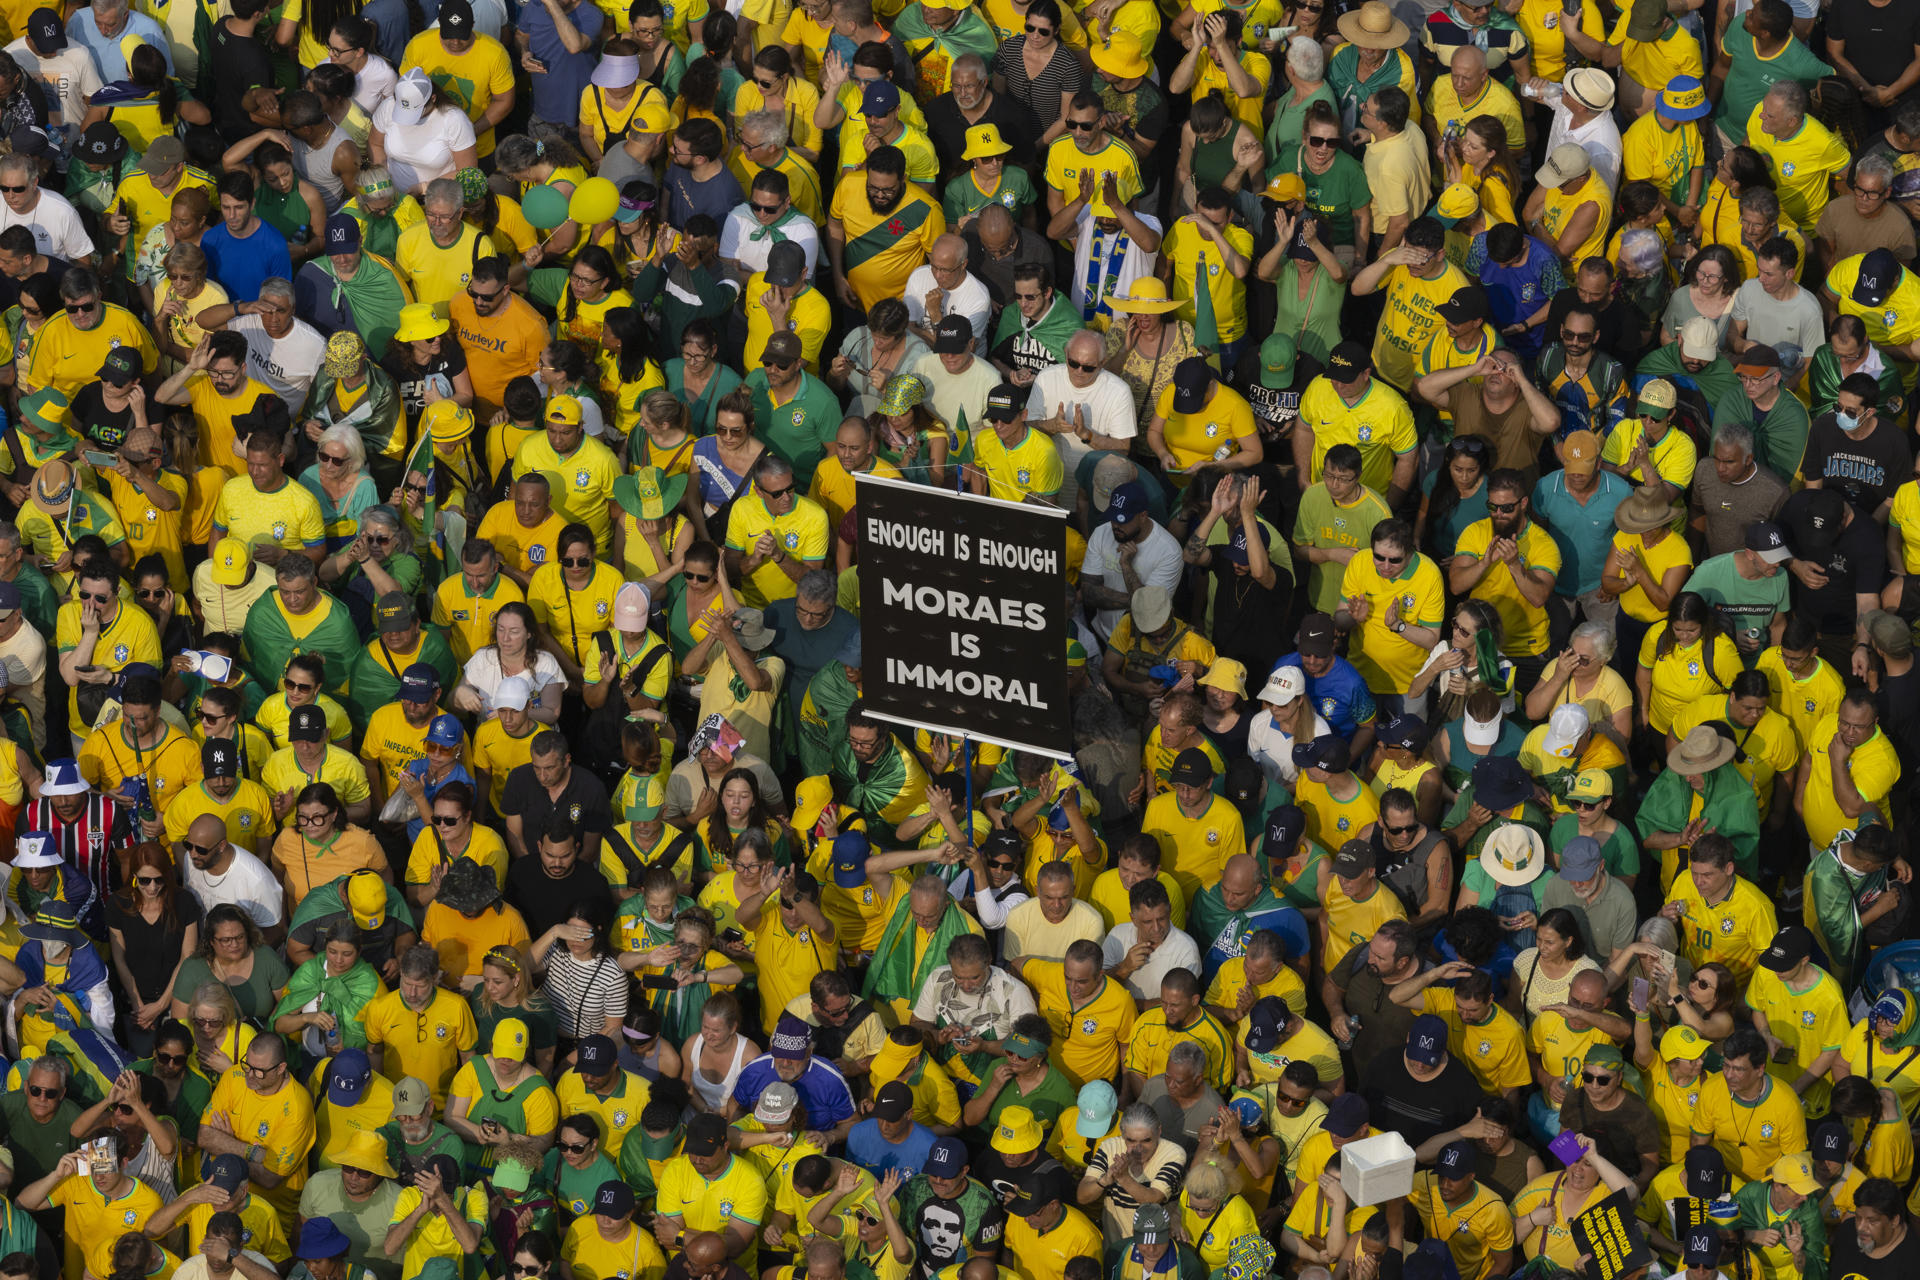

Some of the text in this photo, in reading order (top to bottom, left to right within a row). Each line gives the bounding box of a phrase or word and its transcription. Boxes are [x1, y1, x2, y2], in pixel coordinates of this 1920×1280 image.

[43, 23, 56, 38] M
[332, 228, 345, 242] M
[1861, 273, 1877, 289] M
[460, 327, 494, 348] Hurley
[1249, 384, 1300, 408] PROFIT
[1832, 452, 1876, 466] JACKSONVILLE
[1823, 455, 1886, 487] JAGUARS
[1111, 493, 1126, 509] M
[867, 517, 1057, 574] ENOUGH IS ENOUGH
[1769, 532, 1781, 545] NY
[530, 546, 547, 562] M
[882, 577, 1047, 631] MORAES
[950, 631, 981, 659] IS
[886, 657, 1048, 710] IMMORAL
[213, 750, 225, 763] NY
[1272, 824, 1286, 841] M
[1695, 926, 1713, 951] 10
[1419, 1035, 1434, 1050] M
[584, 1046, 597, 1060] M
[1562, 1056, 1581, 1078] 10
[1825, 1135, 1839, 1149] M
[934, 1147, 949, 1163] M
[1443, 1149, 1459, 1166] M
[1700, 1169, 1714, 1183] M
[601, 1190, 614, 1204] M
[1581, 1212, 1599, 1245] PÚBLICA
[1593, 1241, 1606, 1260] DOS
[1606, 1205, 1633, 1258] DEMOCRACIA
[1595, 1216, 1609, 1235] COM
[1602, 1231, 1624, 1273] CONTAGEM
[1691, 1235, 1709, 1252] M
